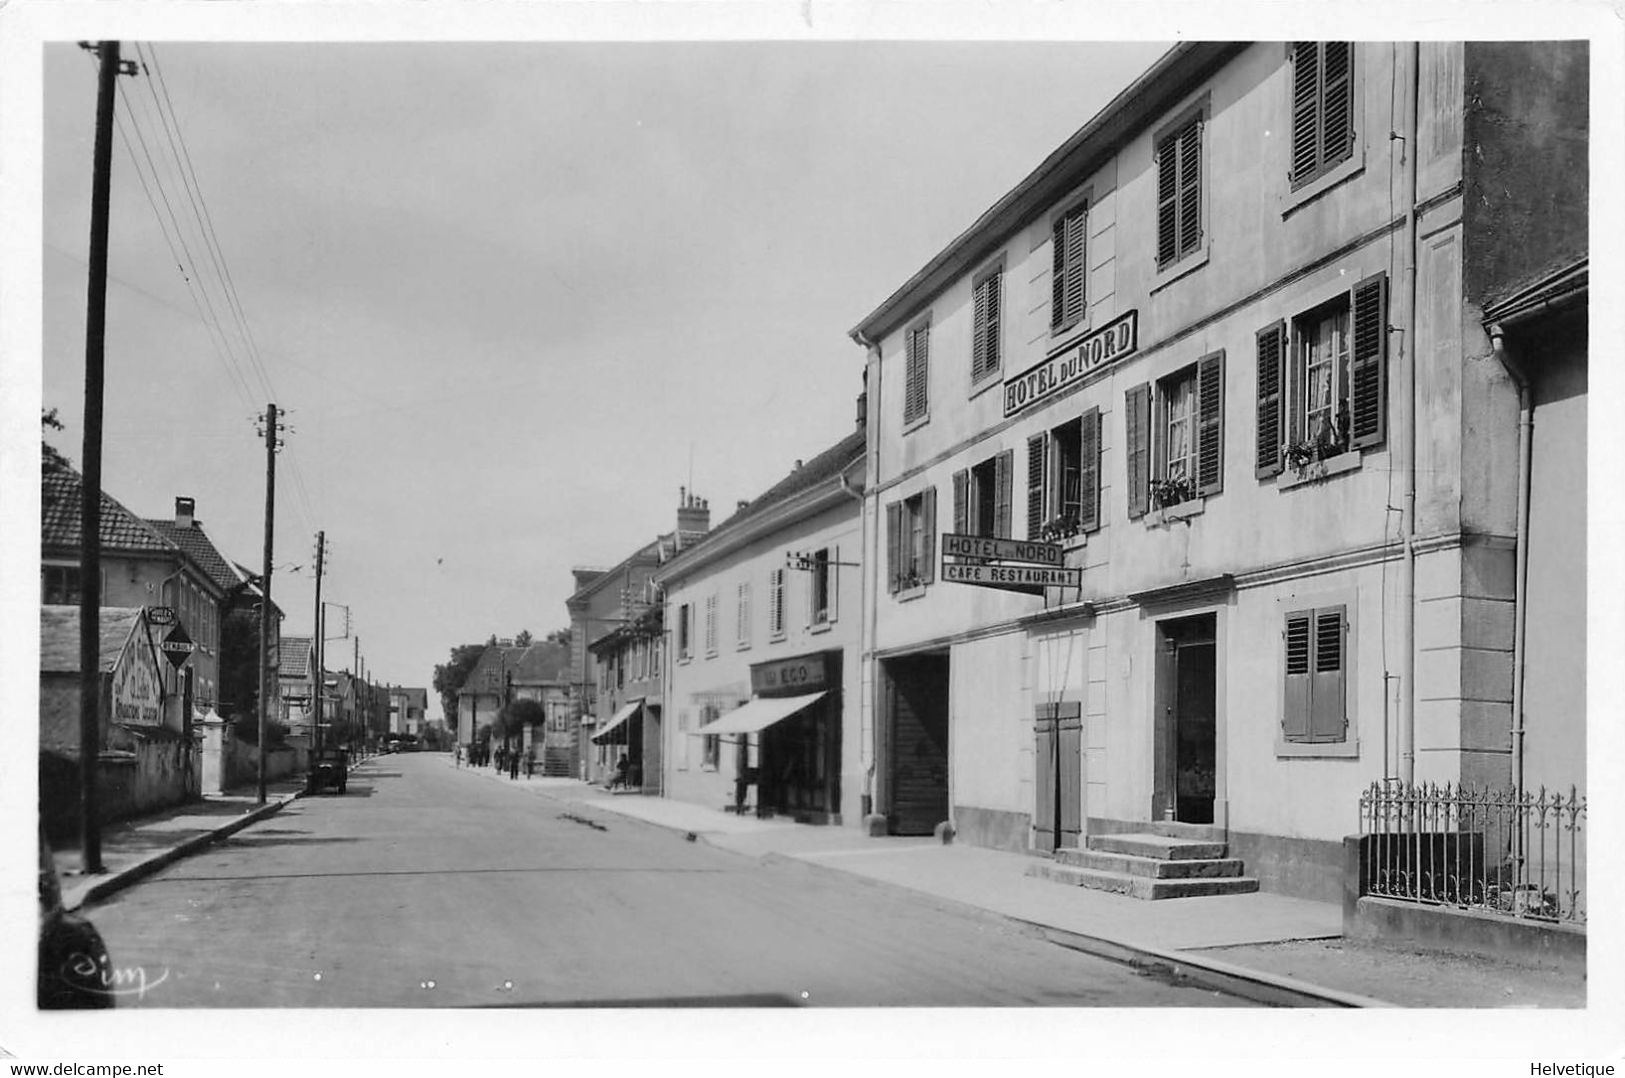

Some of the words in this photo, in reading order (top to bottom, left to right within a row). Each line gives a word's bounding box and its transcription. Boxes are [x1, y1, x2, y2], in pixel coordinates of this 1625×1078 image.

[1006, 363, 1057, 411] HOTEL
[1060, 357, 1077, 382] DU
[1078, 322, 1130, 373] NORD
[950, 538, 1002, 557] HOTEL
[1015, 544, 1057, 562] NORD
[990, 568, 1073, 584] RESTAURANT
